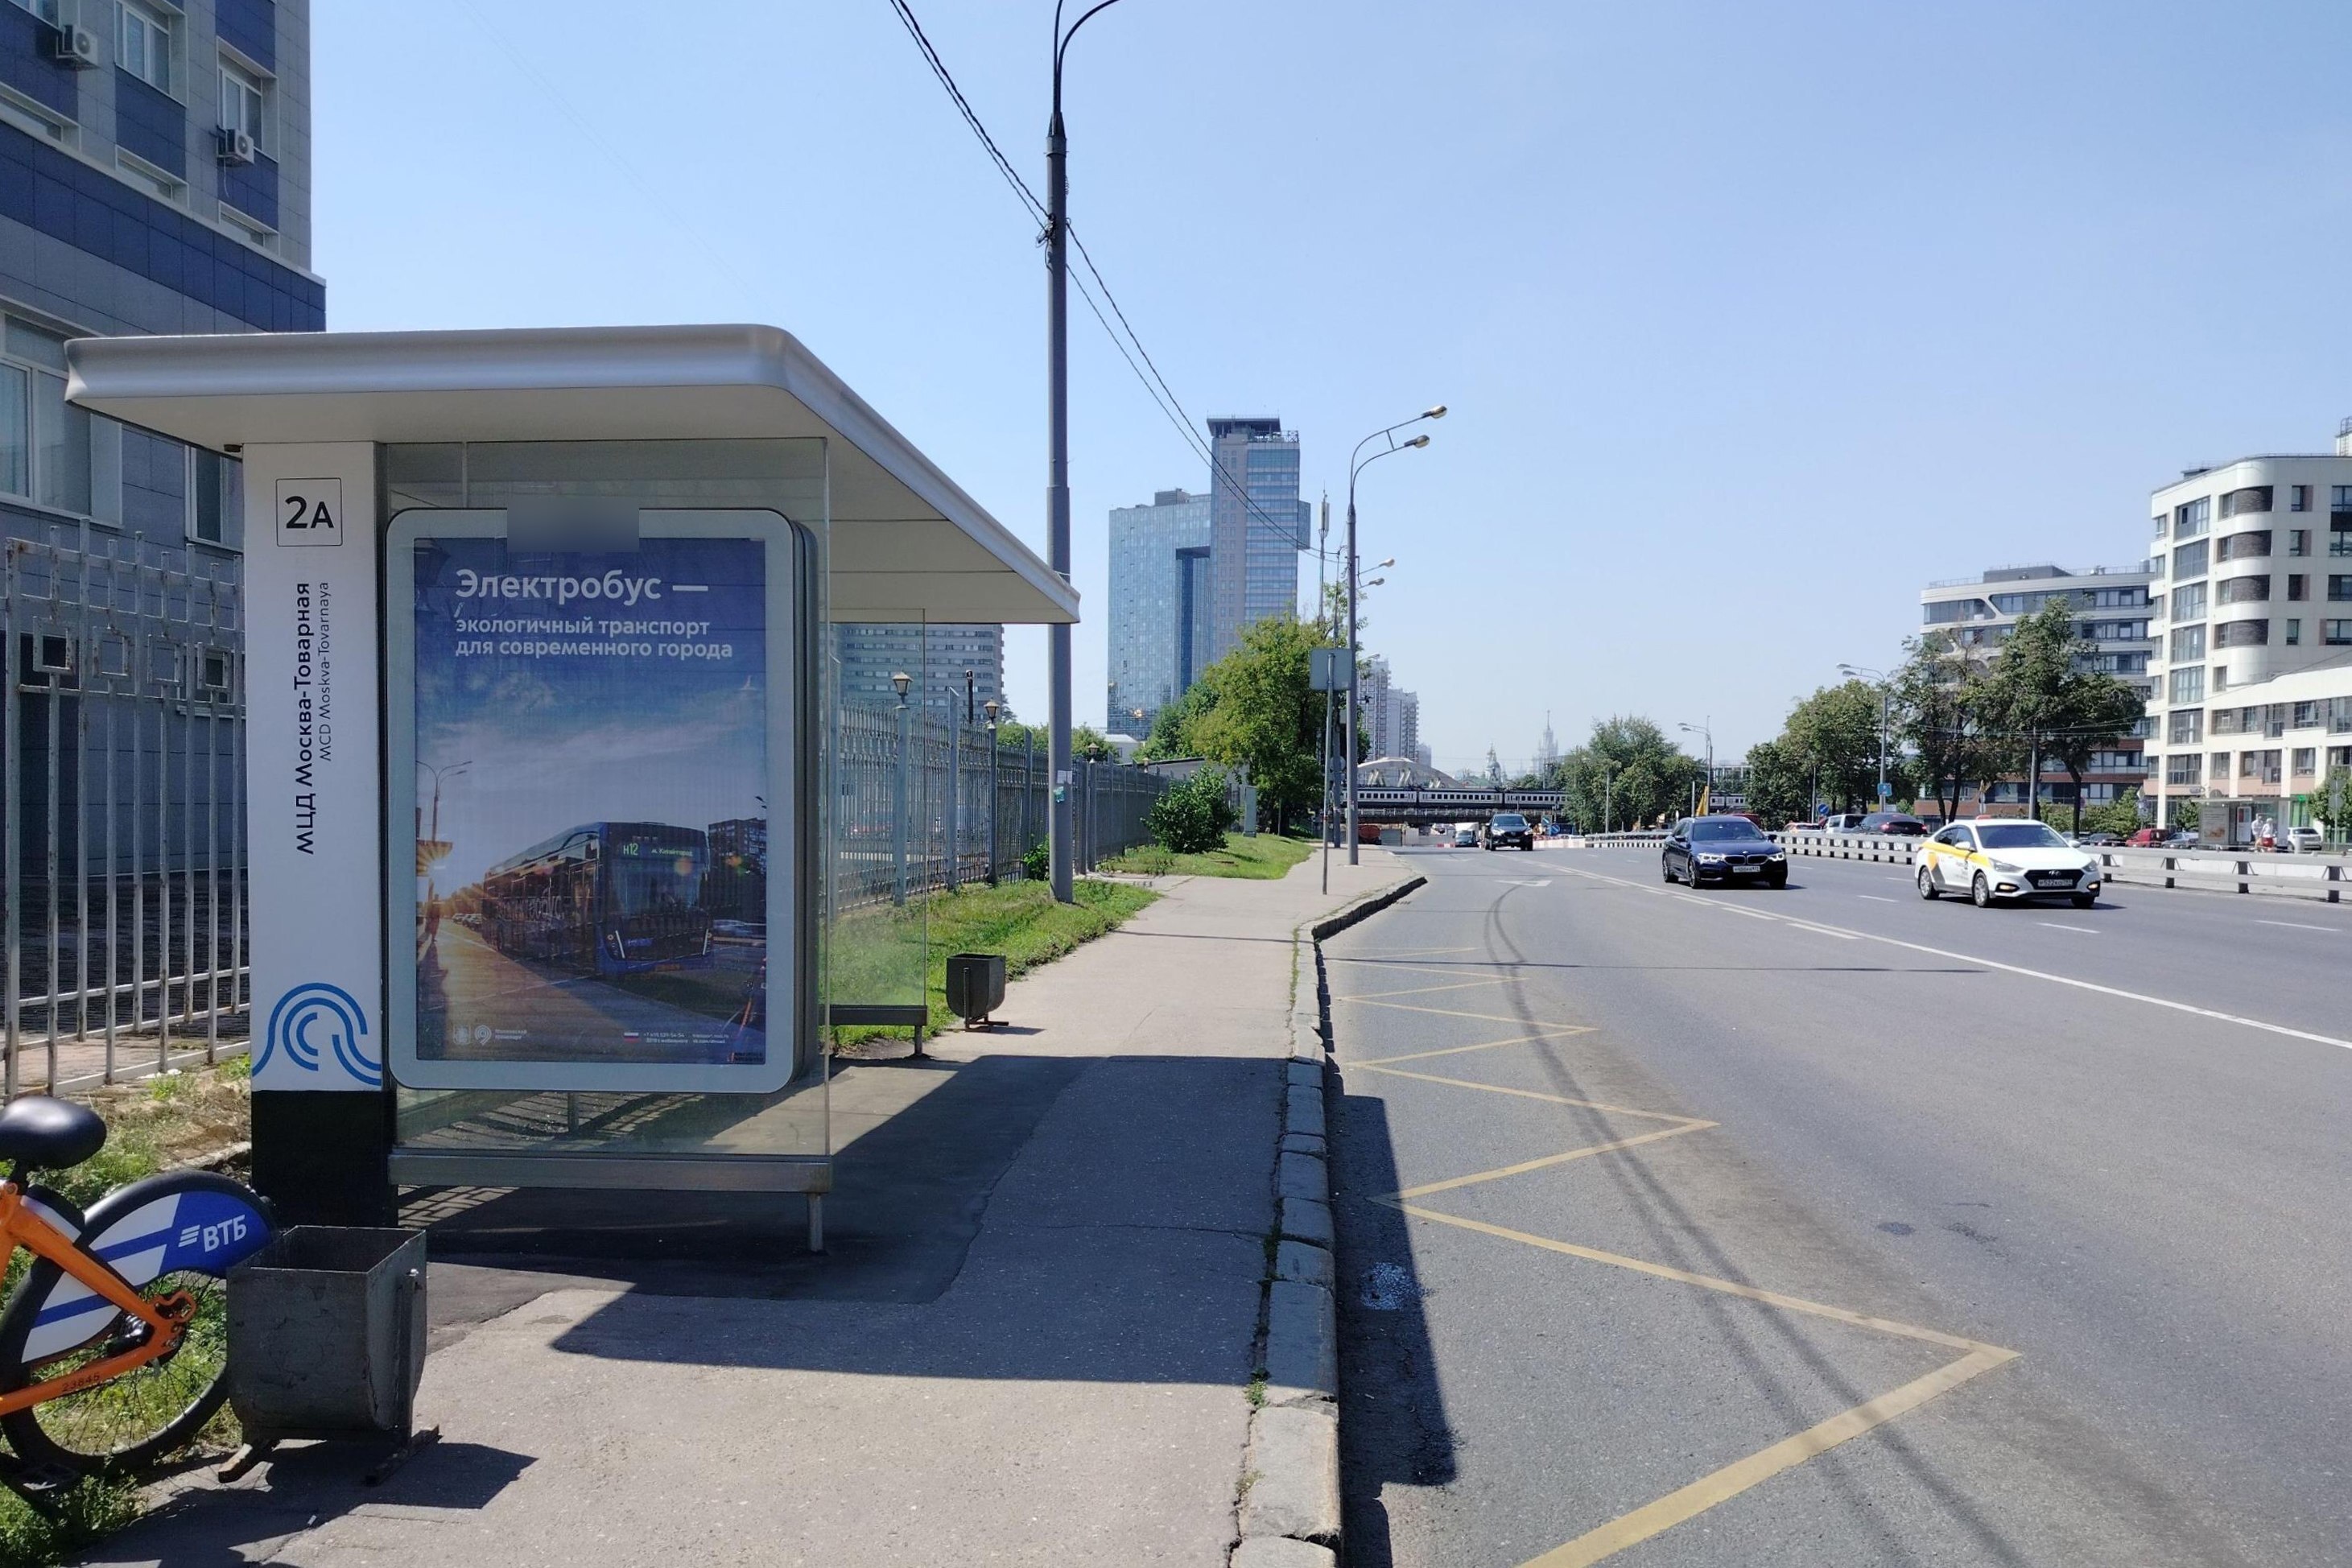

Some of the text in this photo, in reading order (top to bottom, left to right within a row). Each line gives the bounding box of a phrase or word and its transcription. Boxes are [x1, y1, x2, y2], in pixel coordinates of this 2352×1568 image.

[285, 495, 334, 530] 2А
[456, 569, 662, 606] Электробус
[456, 617, 710, 638] экологичный транспорт
[456, 640, 732, 660] для современного города
[317, 582, 332, 761] MCD Moskva-Tovarnaya
[293, 583, 316, 855] МЦД Москва-Товарная
[204, 1215, 247, 1252] ВТБ
